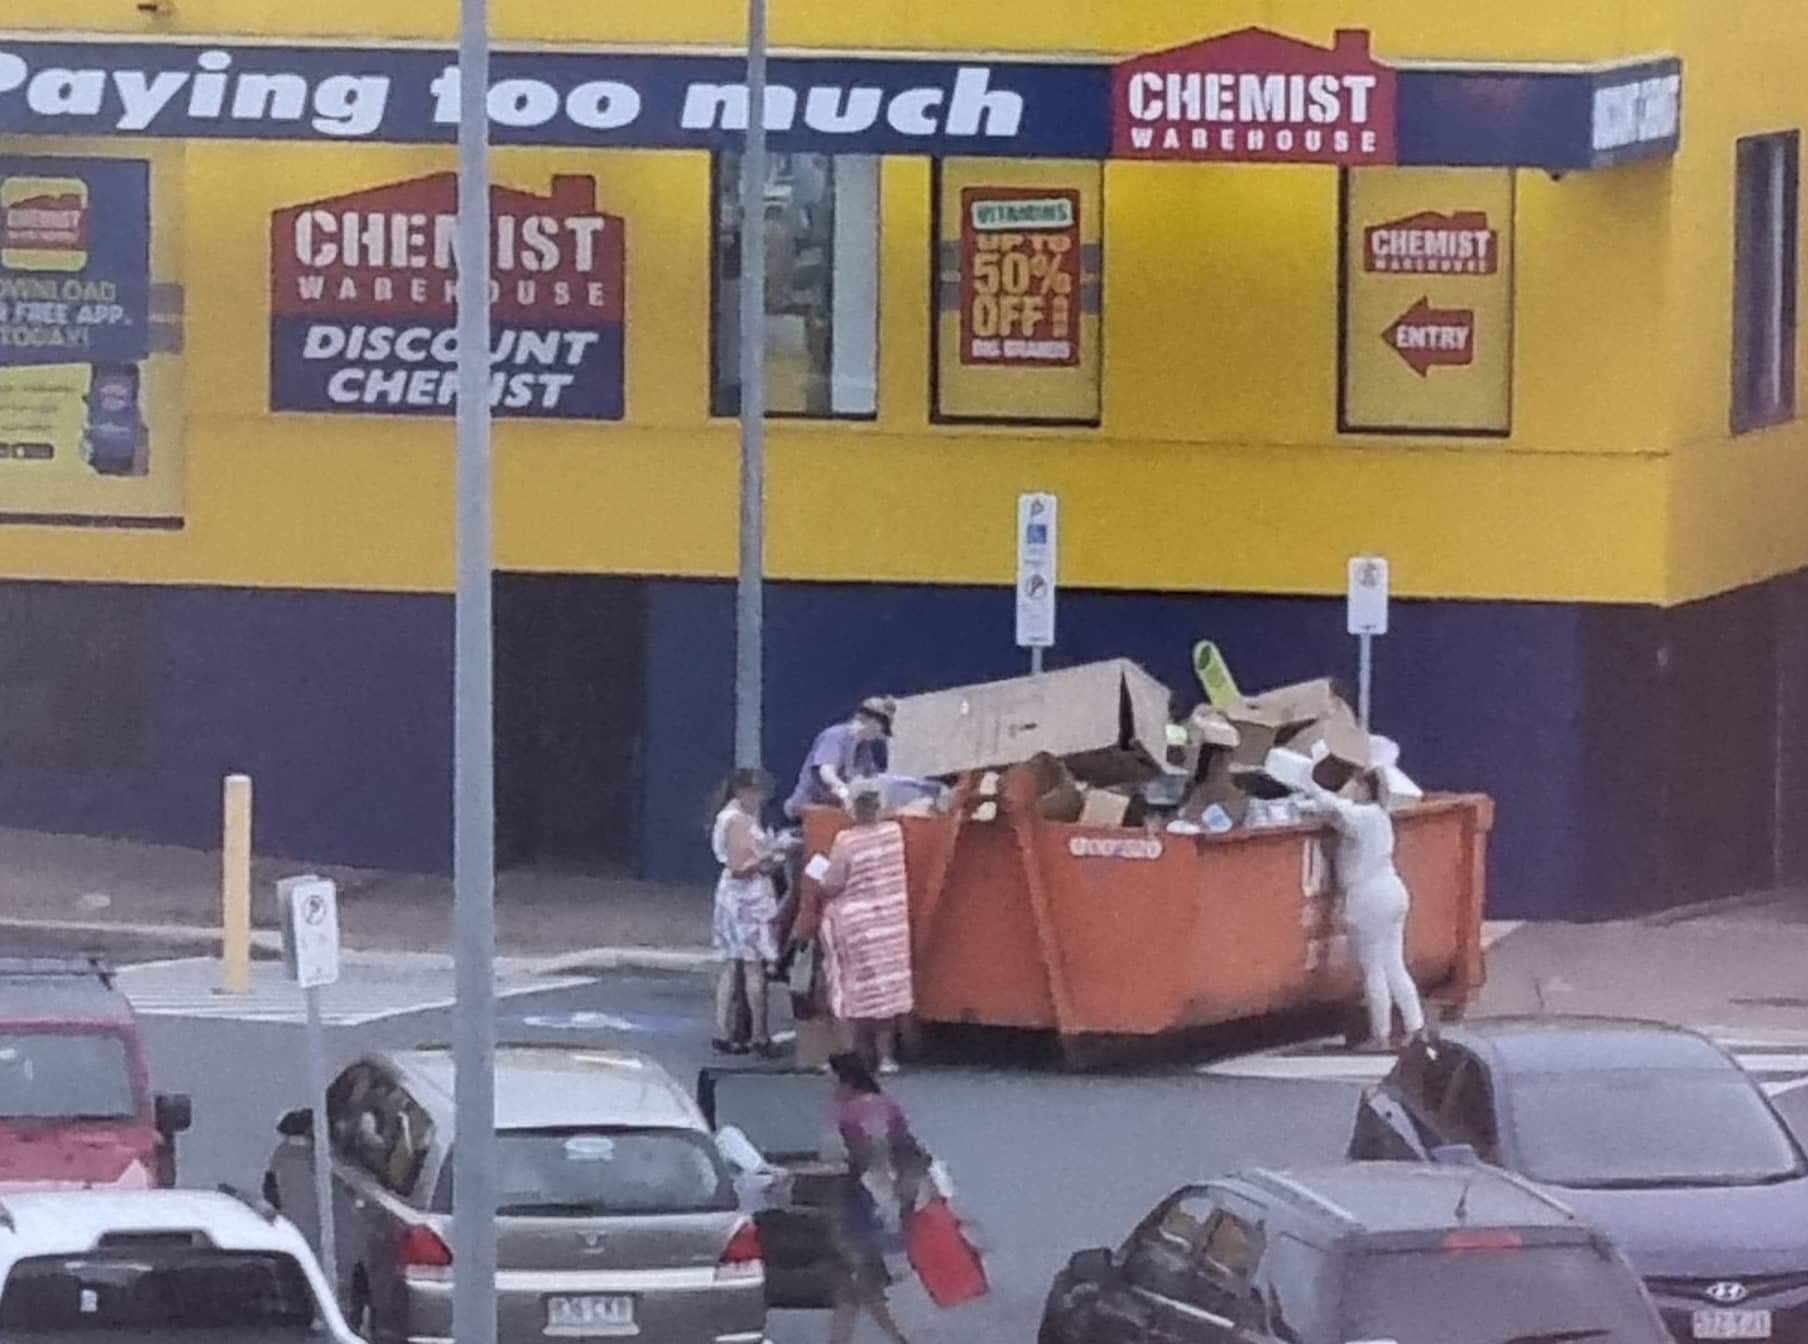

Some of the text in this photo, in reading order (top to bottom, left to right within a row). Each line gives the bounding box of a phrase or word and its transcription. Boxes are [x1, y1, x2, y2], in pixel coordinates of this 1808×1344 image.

[431, 65, 641, 128] too
[682, 68, 1023, 136] much
[1129, 72, 1376, 124] CHEMIST
[1131, 127, 1376, 153] WAREHOUSE
[976, 234, 1024, 252] UP
[1371, 229, 1490, 258] CHEMIST
[973, 252, 1072, 295] 50%
[972, 295, 1043, 337] OFF
[303, 325, 598, 365] DISCOUNT
[1396, 324, 1469, 349] ENTRY
